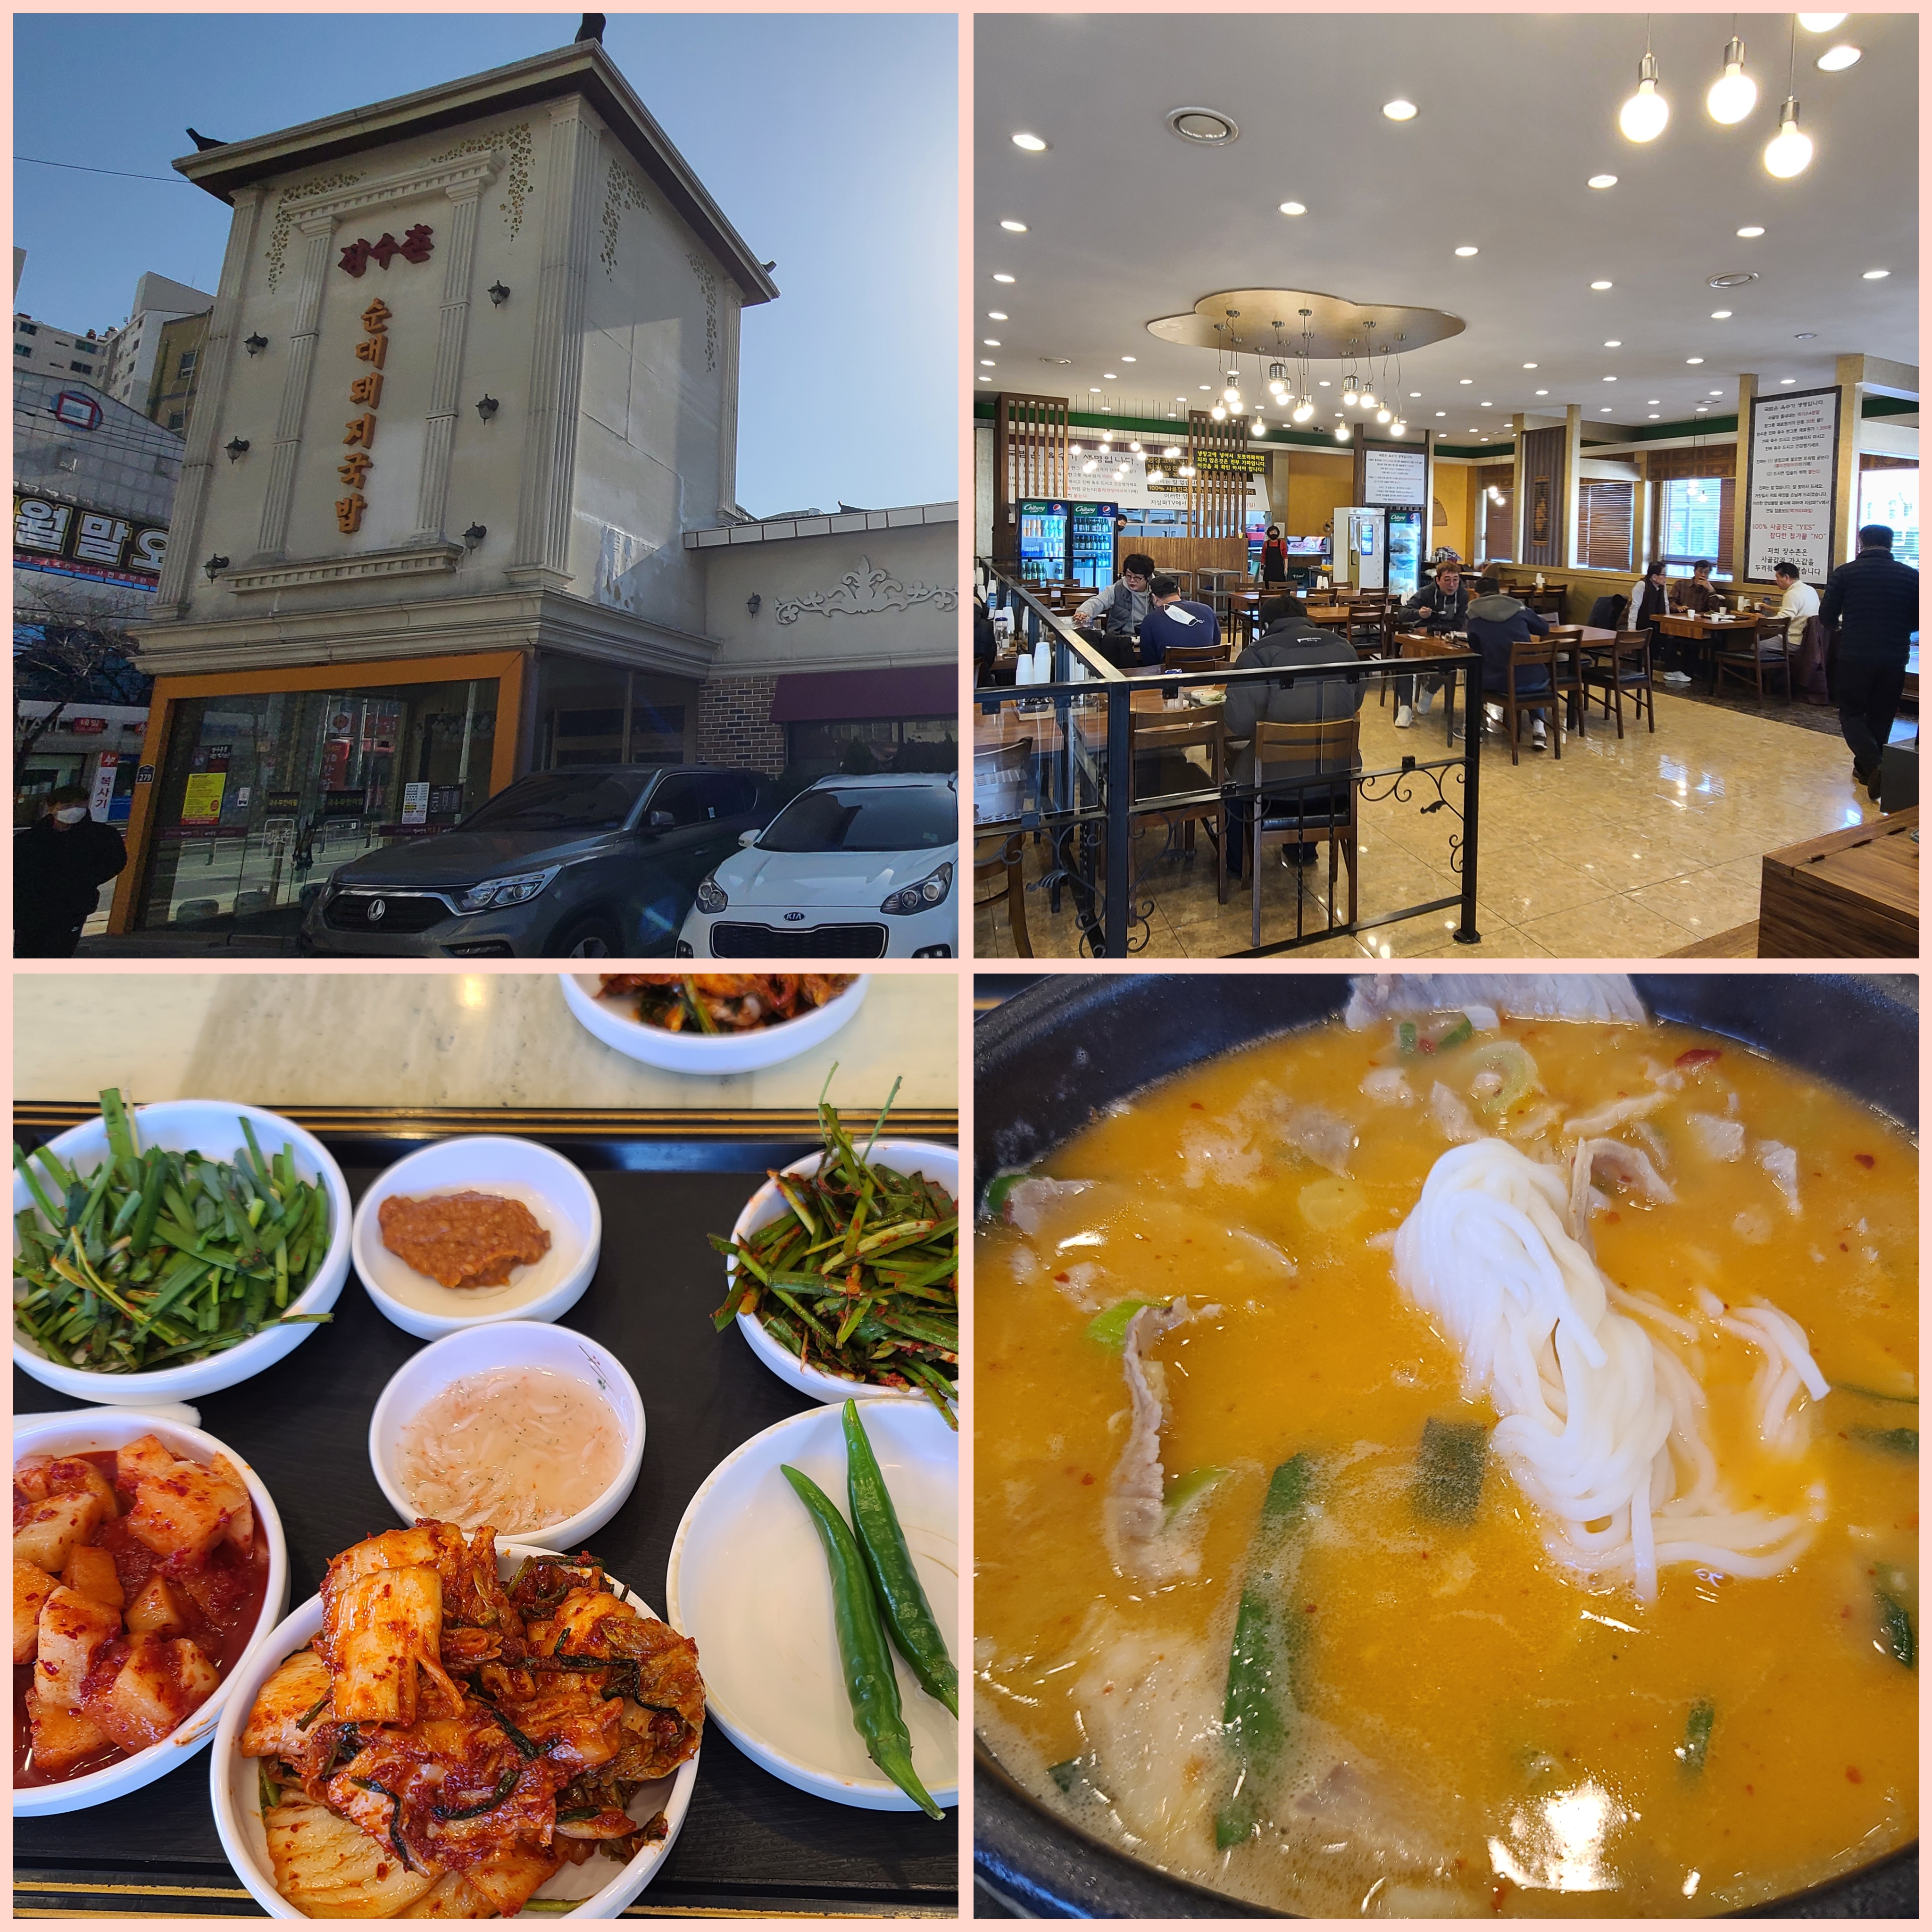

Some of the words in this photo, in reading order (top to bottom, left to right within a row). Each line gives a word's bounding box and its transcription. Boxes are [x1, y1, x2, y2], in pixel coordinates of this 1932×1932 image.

[338, 224, 434, 277] 장수촌
[335, 298, 392, 534] 순대돼지국밥
[14, 498, 168, 571] 월말오
[1782, 548, 1808, 556] 장수촌은
[1789, 557, 1814, 566] 가스값을
[104, 756, 115, 765] hp
[96, 776, 111, 808] 복사기
